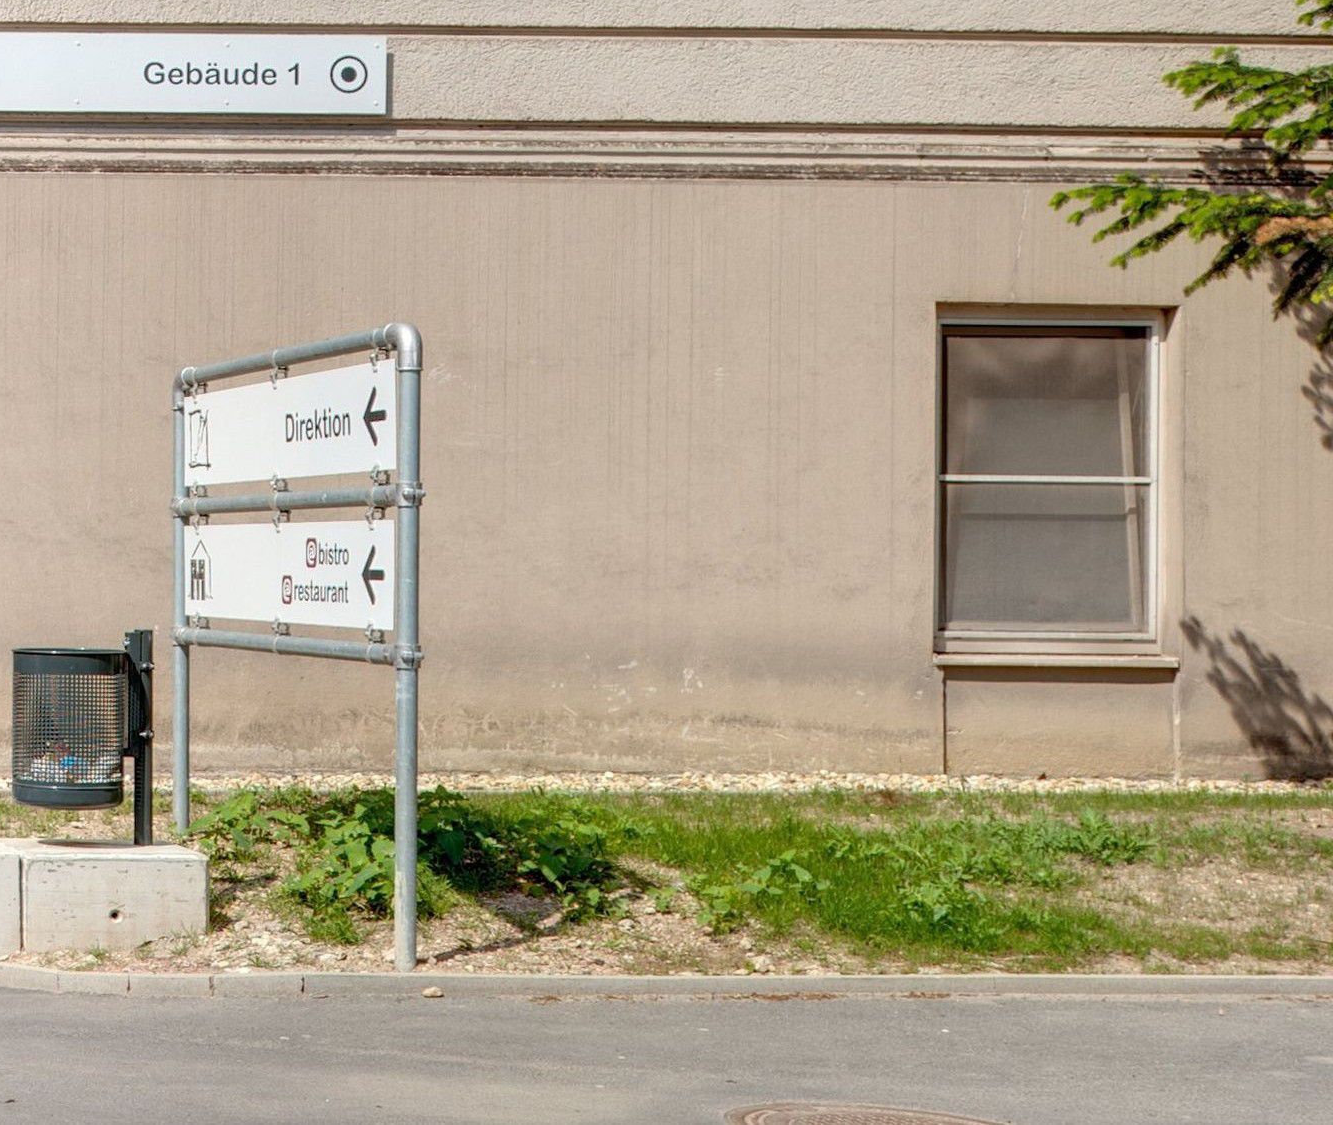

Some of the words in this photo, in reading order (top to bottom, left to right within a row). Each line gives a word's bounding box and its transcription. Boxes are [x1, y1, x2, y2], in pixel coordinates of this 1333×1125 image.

[143, 61, 278, 86] Gebäude
[288, 63, 301, 86] 1
[285, 407, 351, 443] Direktion
